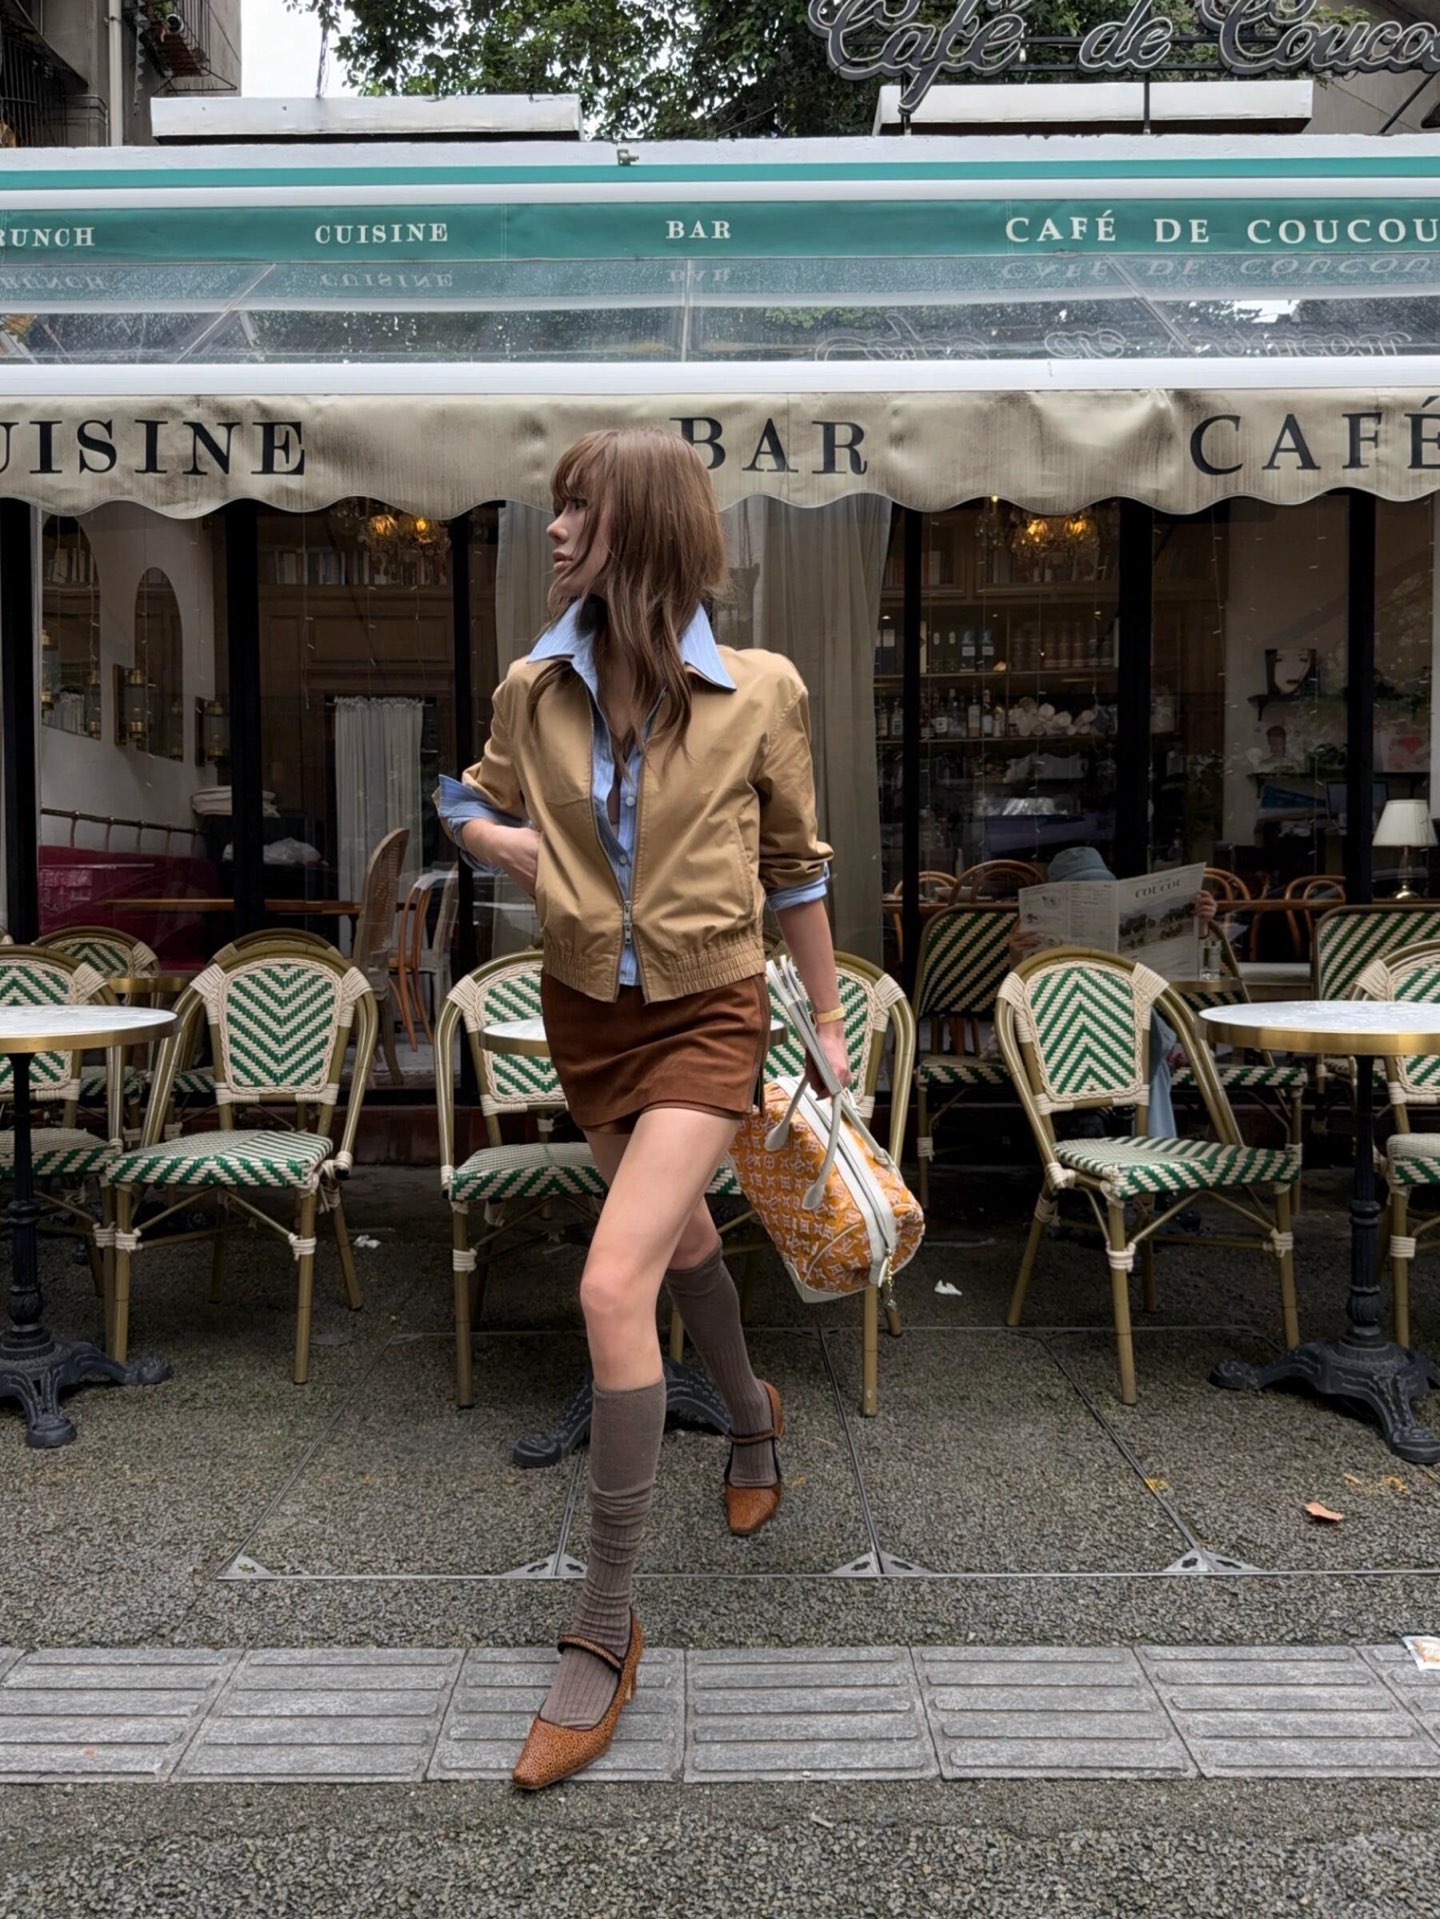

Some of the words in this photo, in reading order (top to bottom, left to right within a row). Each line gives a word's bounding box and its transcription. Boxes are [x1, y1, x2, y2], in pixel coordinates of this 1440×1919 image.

[1077, 0, 1174, 73] de
[1201, 0, 1440, 75] Couco
[0, 227, 95, 247] UNCH
[315, 223, 448, 244] CUISINE
[665, 220, 731, 239] BAR
[1005, 210, 1116, 242] CAFÉ
[1154, 218, 1209, 243] DE
[1247, 218, 1439, 244] COUCOU
[669, 417, 868, 475] BAR
[1190, 395, 1440, 476] CAFÉ
